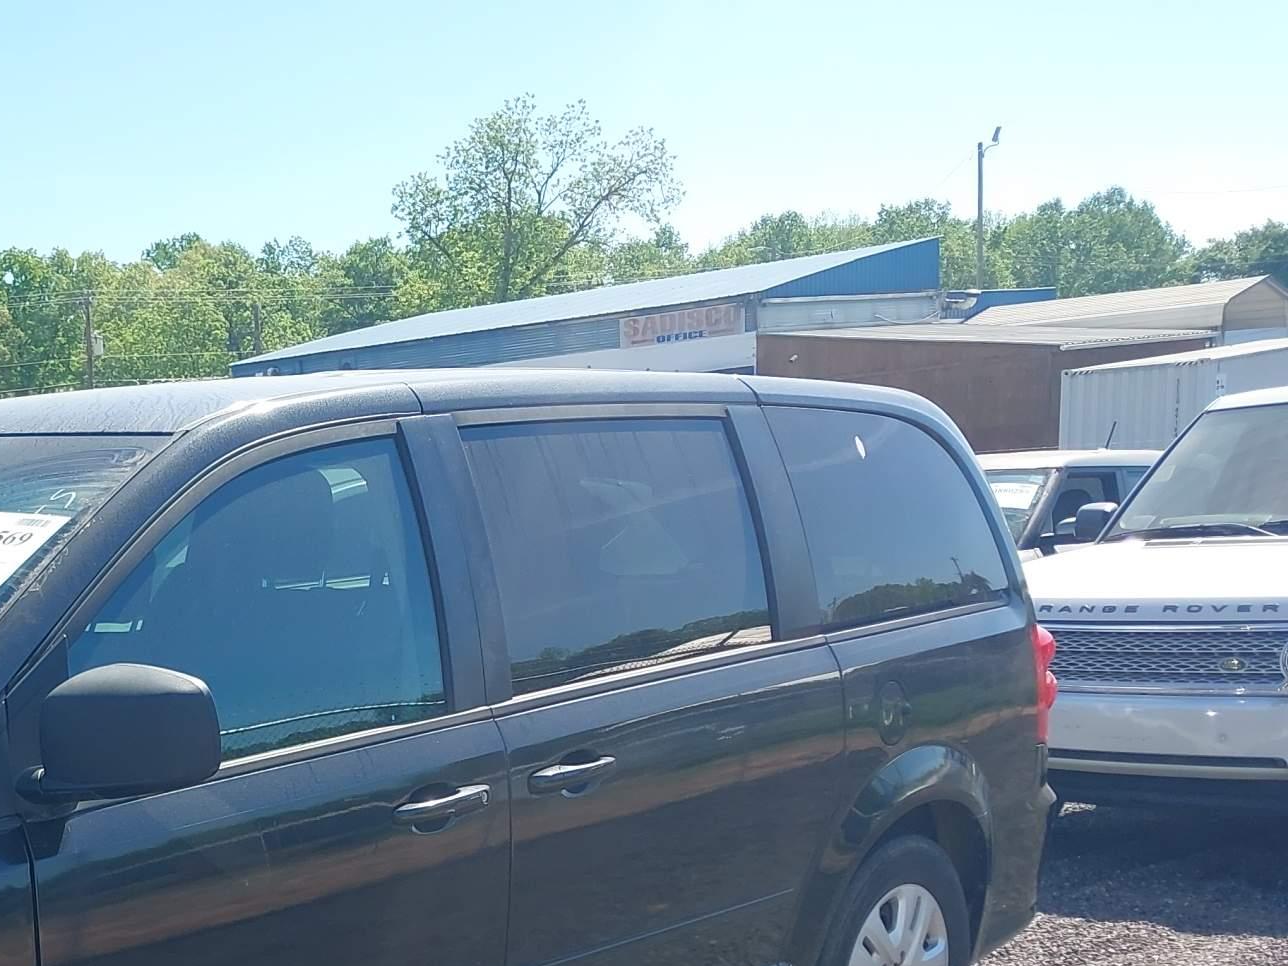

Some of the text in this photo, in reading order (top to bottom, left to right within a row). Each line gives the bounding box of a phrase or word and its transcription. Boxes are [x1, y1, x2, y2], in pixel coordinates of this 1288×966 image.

[656, 330, 708, 344] OFFICE
[1039, 603, 1280, 614] RANGE ROVER
